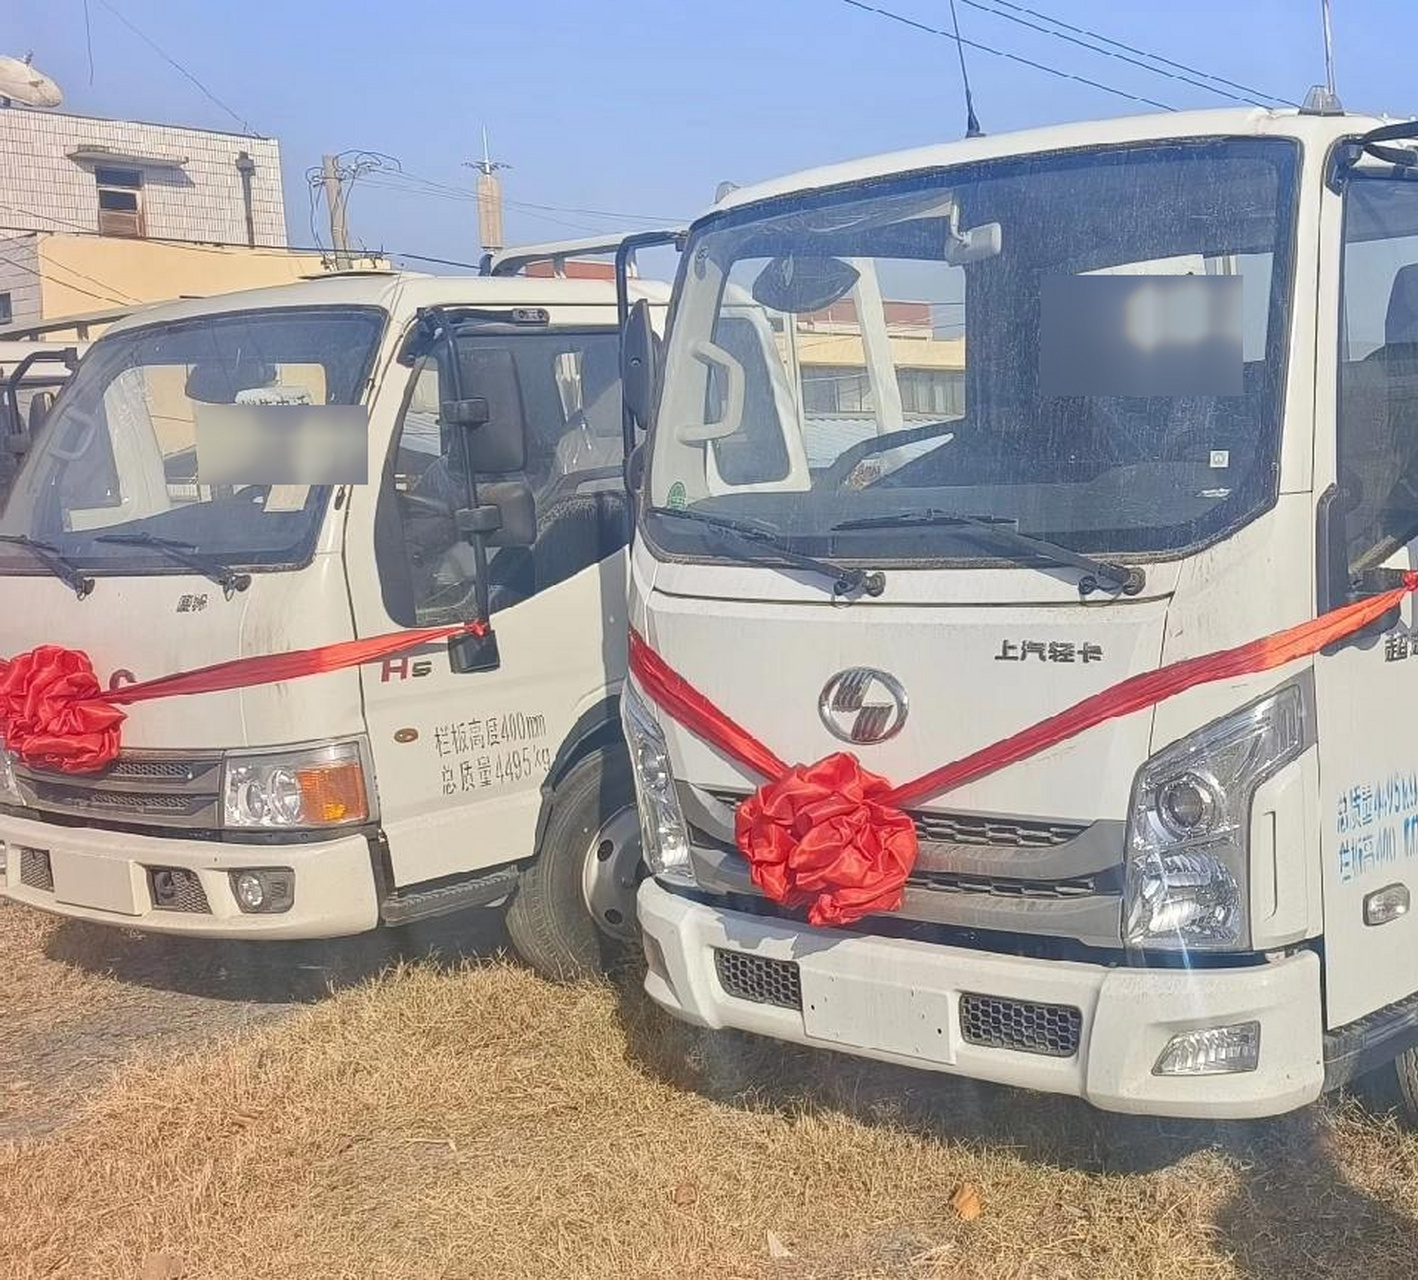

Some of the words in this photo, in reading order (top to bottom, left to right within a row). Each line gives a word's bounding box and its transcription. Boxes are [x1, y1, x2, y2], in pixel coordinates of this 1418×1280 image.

[994, 639, 1103, 663] 上汽轻卡
[381, 654, 432, 682] H5
[434, 711, 547, 757] 栏板高度400mm
